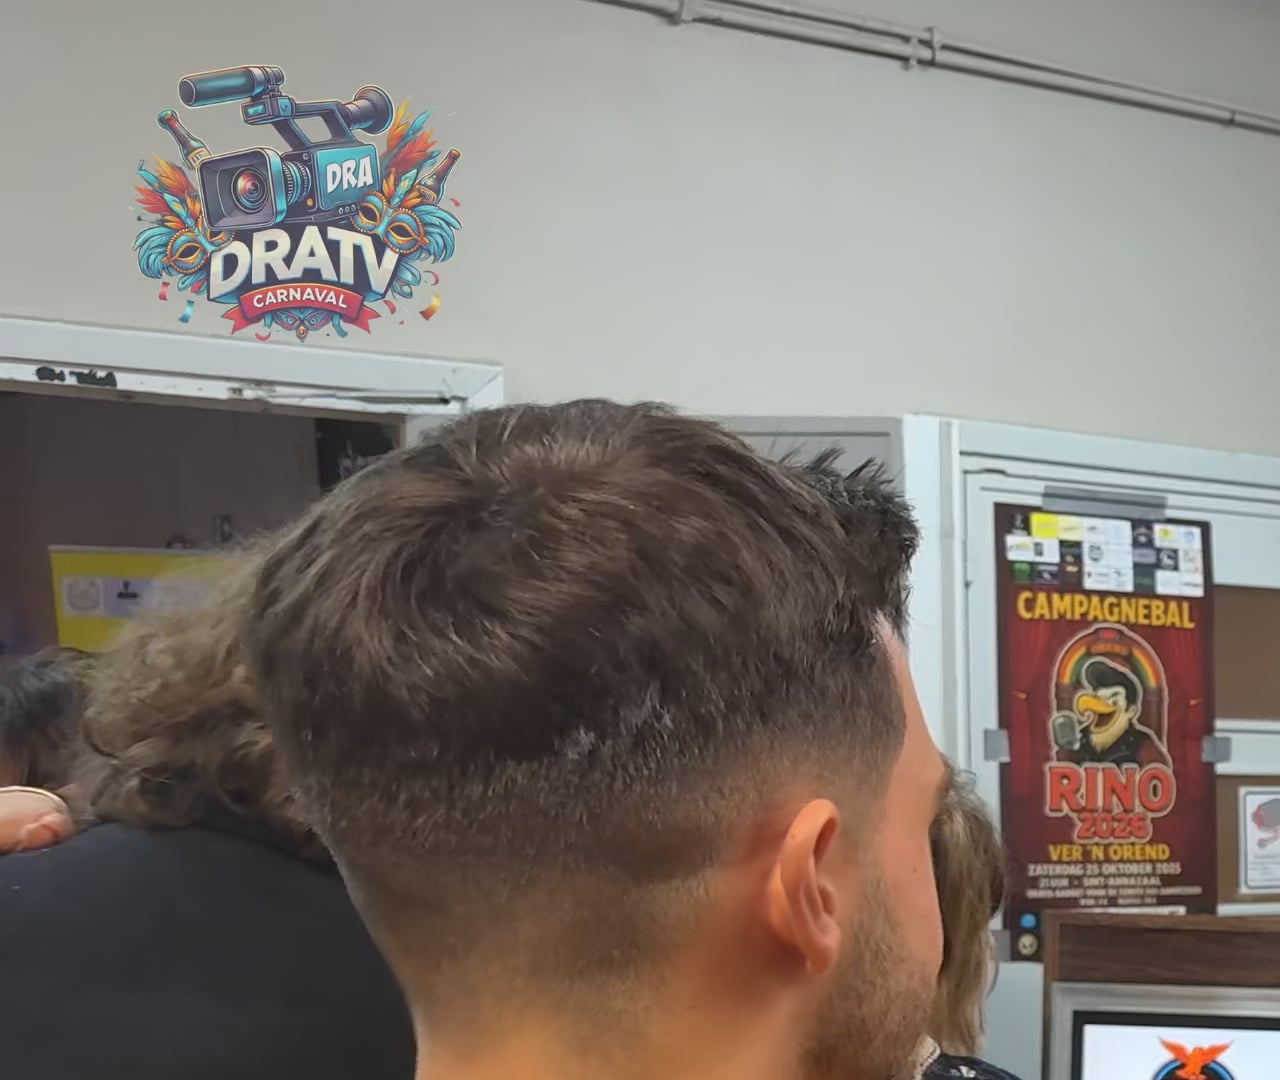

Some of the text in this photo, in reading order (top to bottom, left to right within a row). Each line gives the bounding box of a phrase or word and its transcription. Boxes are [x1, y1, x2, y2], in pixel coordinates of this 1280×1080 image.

[1016, 589, 1197, 630] CAMPAGNEBAL
[1047, 764, 1173, 815] RINO
[1076, 811, 1150, 841] 2026
[1050, 843, 1084, 862] VER
[1108, 842, 1171, 861] OREND
[1101, 861, 1153, 875] OKTOBER
